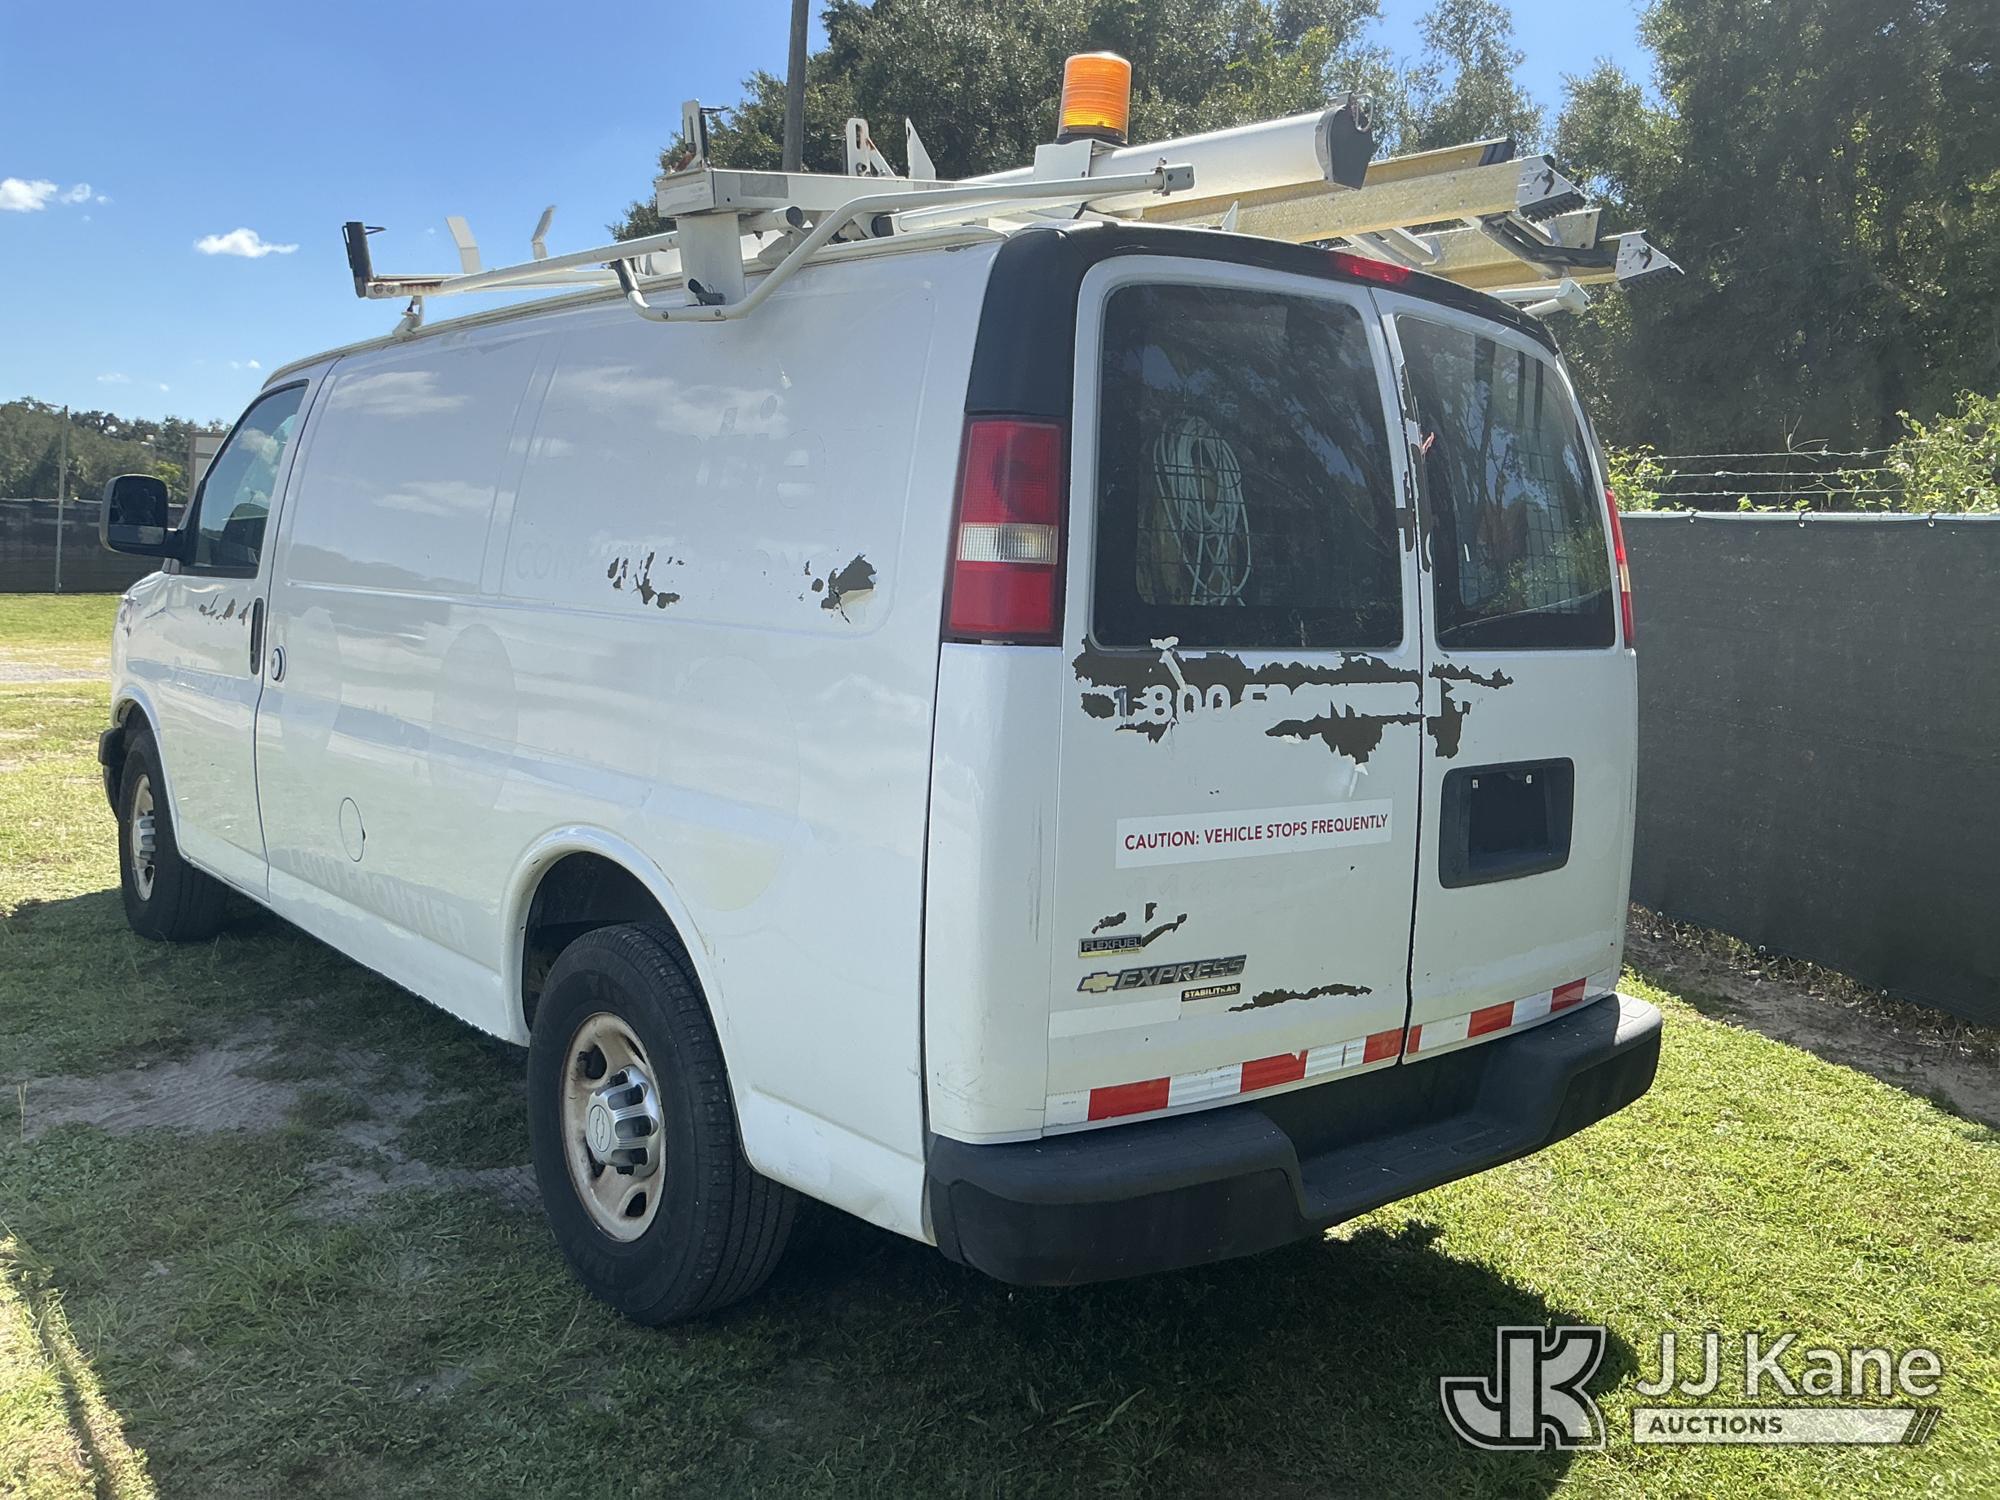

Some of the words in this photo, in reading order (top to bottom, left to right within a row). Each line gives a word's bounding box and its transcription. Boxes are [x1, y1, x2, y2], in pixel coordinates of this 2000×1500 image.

[1124, 830, 1201, 851] CAUTION:
[1204, 825, 1262, 845] VEHICLE
[1267, 820, 1308, 839] STOPS
[1311, 813, 1389, 836] FREQUENTLY
[1082, 937, 1141, 952] FLEXFUEL
[1117, 956, 1247, 990] EXPRESS
